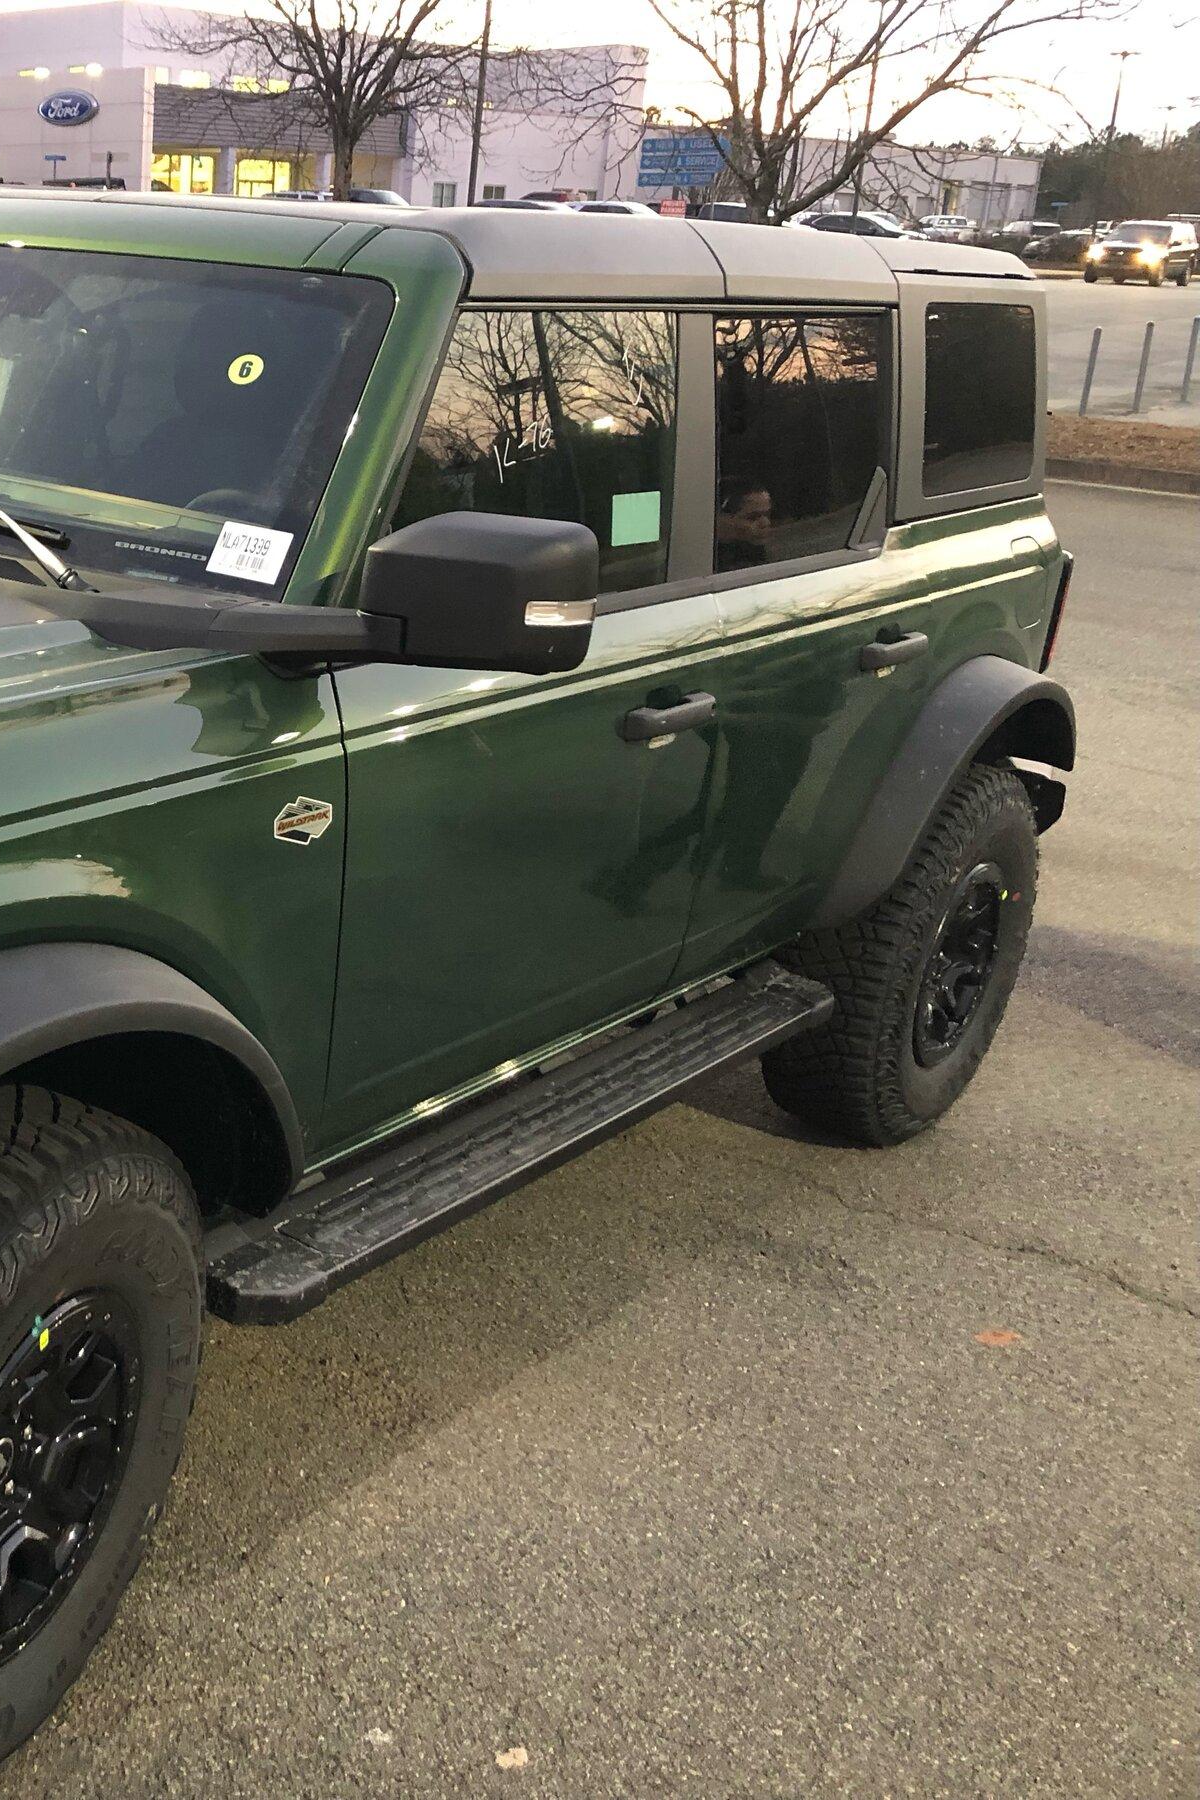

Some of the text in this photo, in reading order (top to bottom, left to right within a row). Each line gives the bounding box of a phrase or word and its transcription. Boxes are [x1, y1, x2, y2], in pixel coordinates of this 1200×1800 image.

[48, 97, 80, 118] Ford
[239, 360, 254, 378] 6
[114, 541, 208, 562] BRONCO
[277, 809, 330, 831] WILDTRAK
